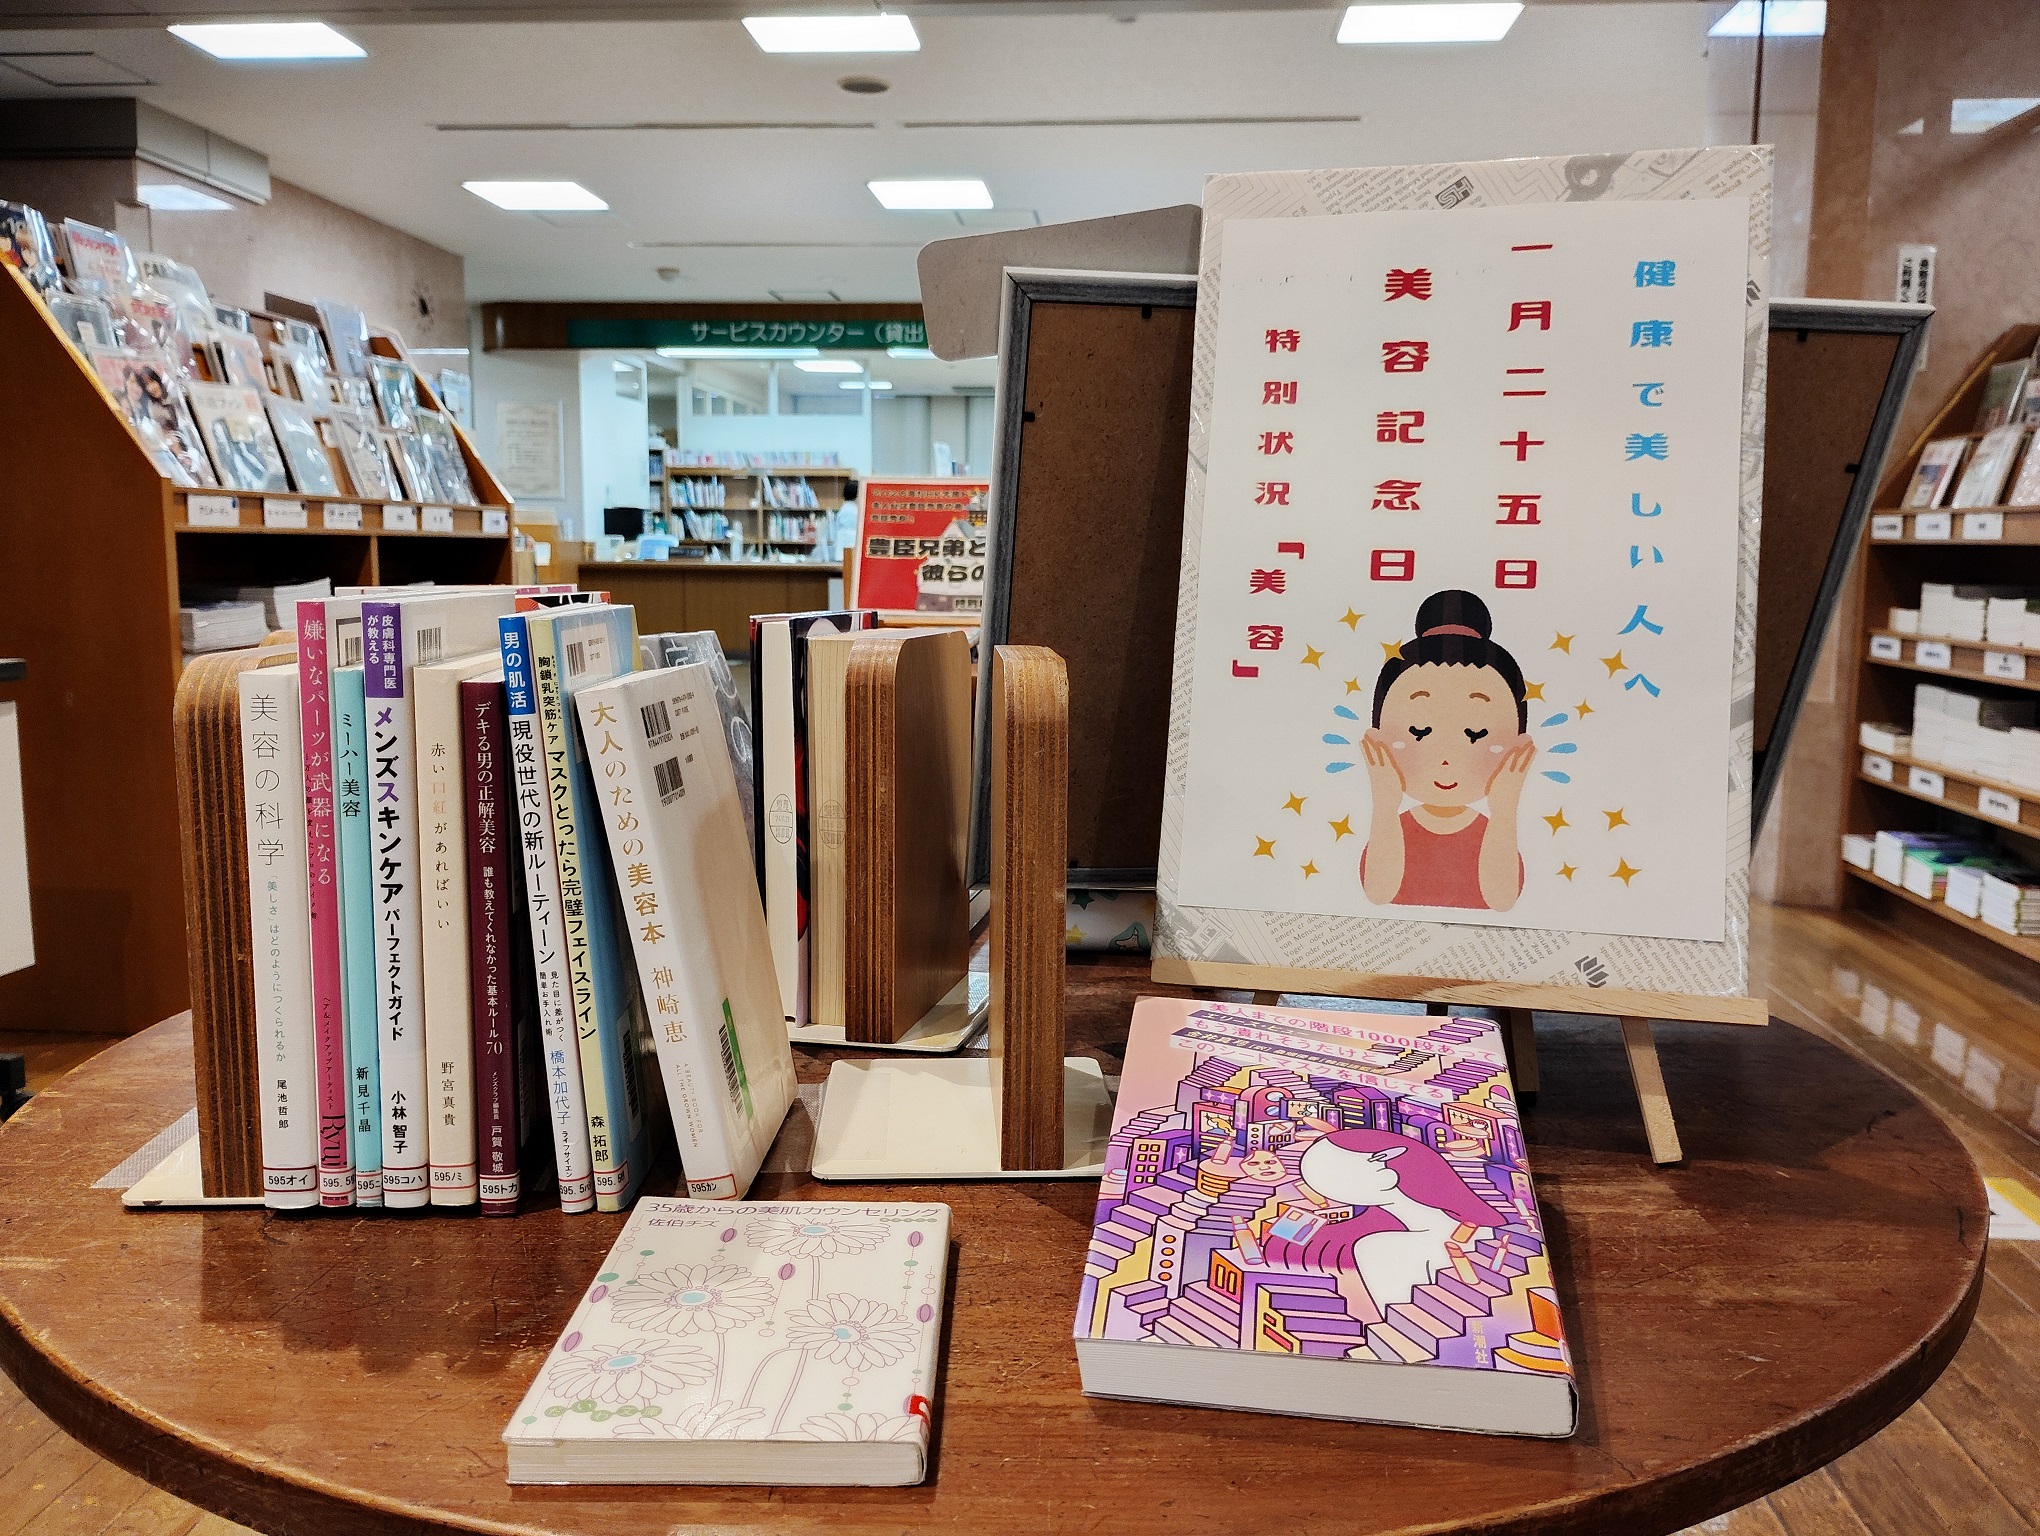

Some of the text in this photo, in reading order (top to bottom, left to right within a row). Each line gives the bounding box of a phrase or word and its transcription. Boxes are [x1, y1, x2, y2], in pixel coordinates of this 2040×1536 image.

[1369, 268, 1434, 582] 美容記念日
[1494, 243, 1554, 589] 一月二十五日
[1617, 259, 1676, 699] 健康で美しい人へ
[366, 614, 380, 665] が教える
[381, 614, 398, 690] 皮膚科専門医
[503, 632, 527, 709] 男の肌活
[250, 693, 285, 866] 美容の科学
[303, 618, 332, 885] 嫌いなパーツが武器になる
[340, 713, 361, 818] ミーハー美容
[474, 701, 496, 854] デキる男の正解美容
[373, 706, 403, 906] メンズスキンケア
[430, 743, 451, 930] 赤い口紅があればいい
[511, 720, 555, 965] 現役世代の新ルーティーン
[590, 702, 666, 945] 大人のための美容本
[547, 750, 597, 1040] マスクとったら完璧フェイスライン
[1303, 943, 1321, 957] oder
[1308, 930, 1325, 944] oder
[1378, 933, 1395, 947] oder
[1392, 934, 1411, 949] auch
[384, 908, 404, 1042] パーフェクトガイド
[550, 971, 565, 1042] 見た目に差がつく
[1178, 1038, 1444, 1098] このシートマスクを信じてる
[1194, 1020, 1377, 1062] もう潰れそうだけど
[1209, 1003, 1496, 1062] 美人までの階段1000段あって
[276, 1079, 289, 1129] 尾池哲郎
[356, 1066, 371, 1132] 新見千晶
[441, 1061, 456, 1126] 野宮真貴
[549, 1049, 571, 1125] 橋本加代子
[268, 1174, 309, 1186] 595オイ
[645, 1202, 941, 1217] 35歳からの美肌カウンセリング
[647, 1218, 720, 1228] 佐伯チズ
[1471, 1320, 1488, 1364] 新潮社
